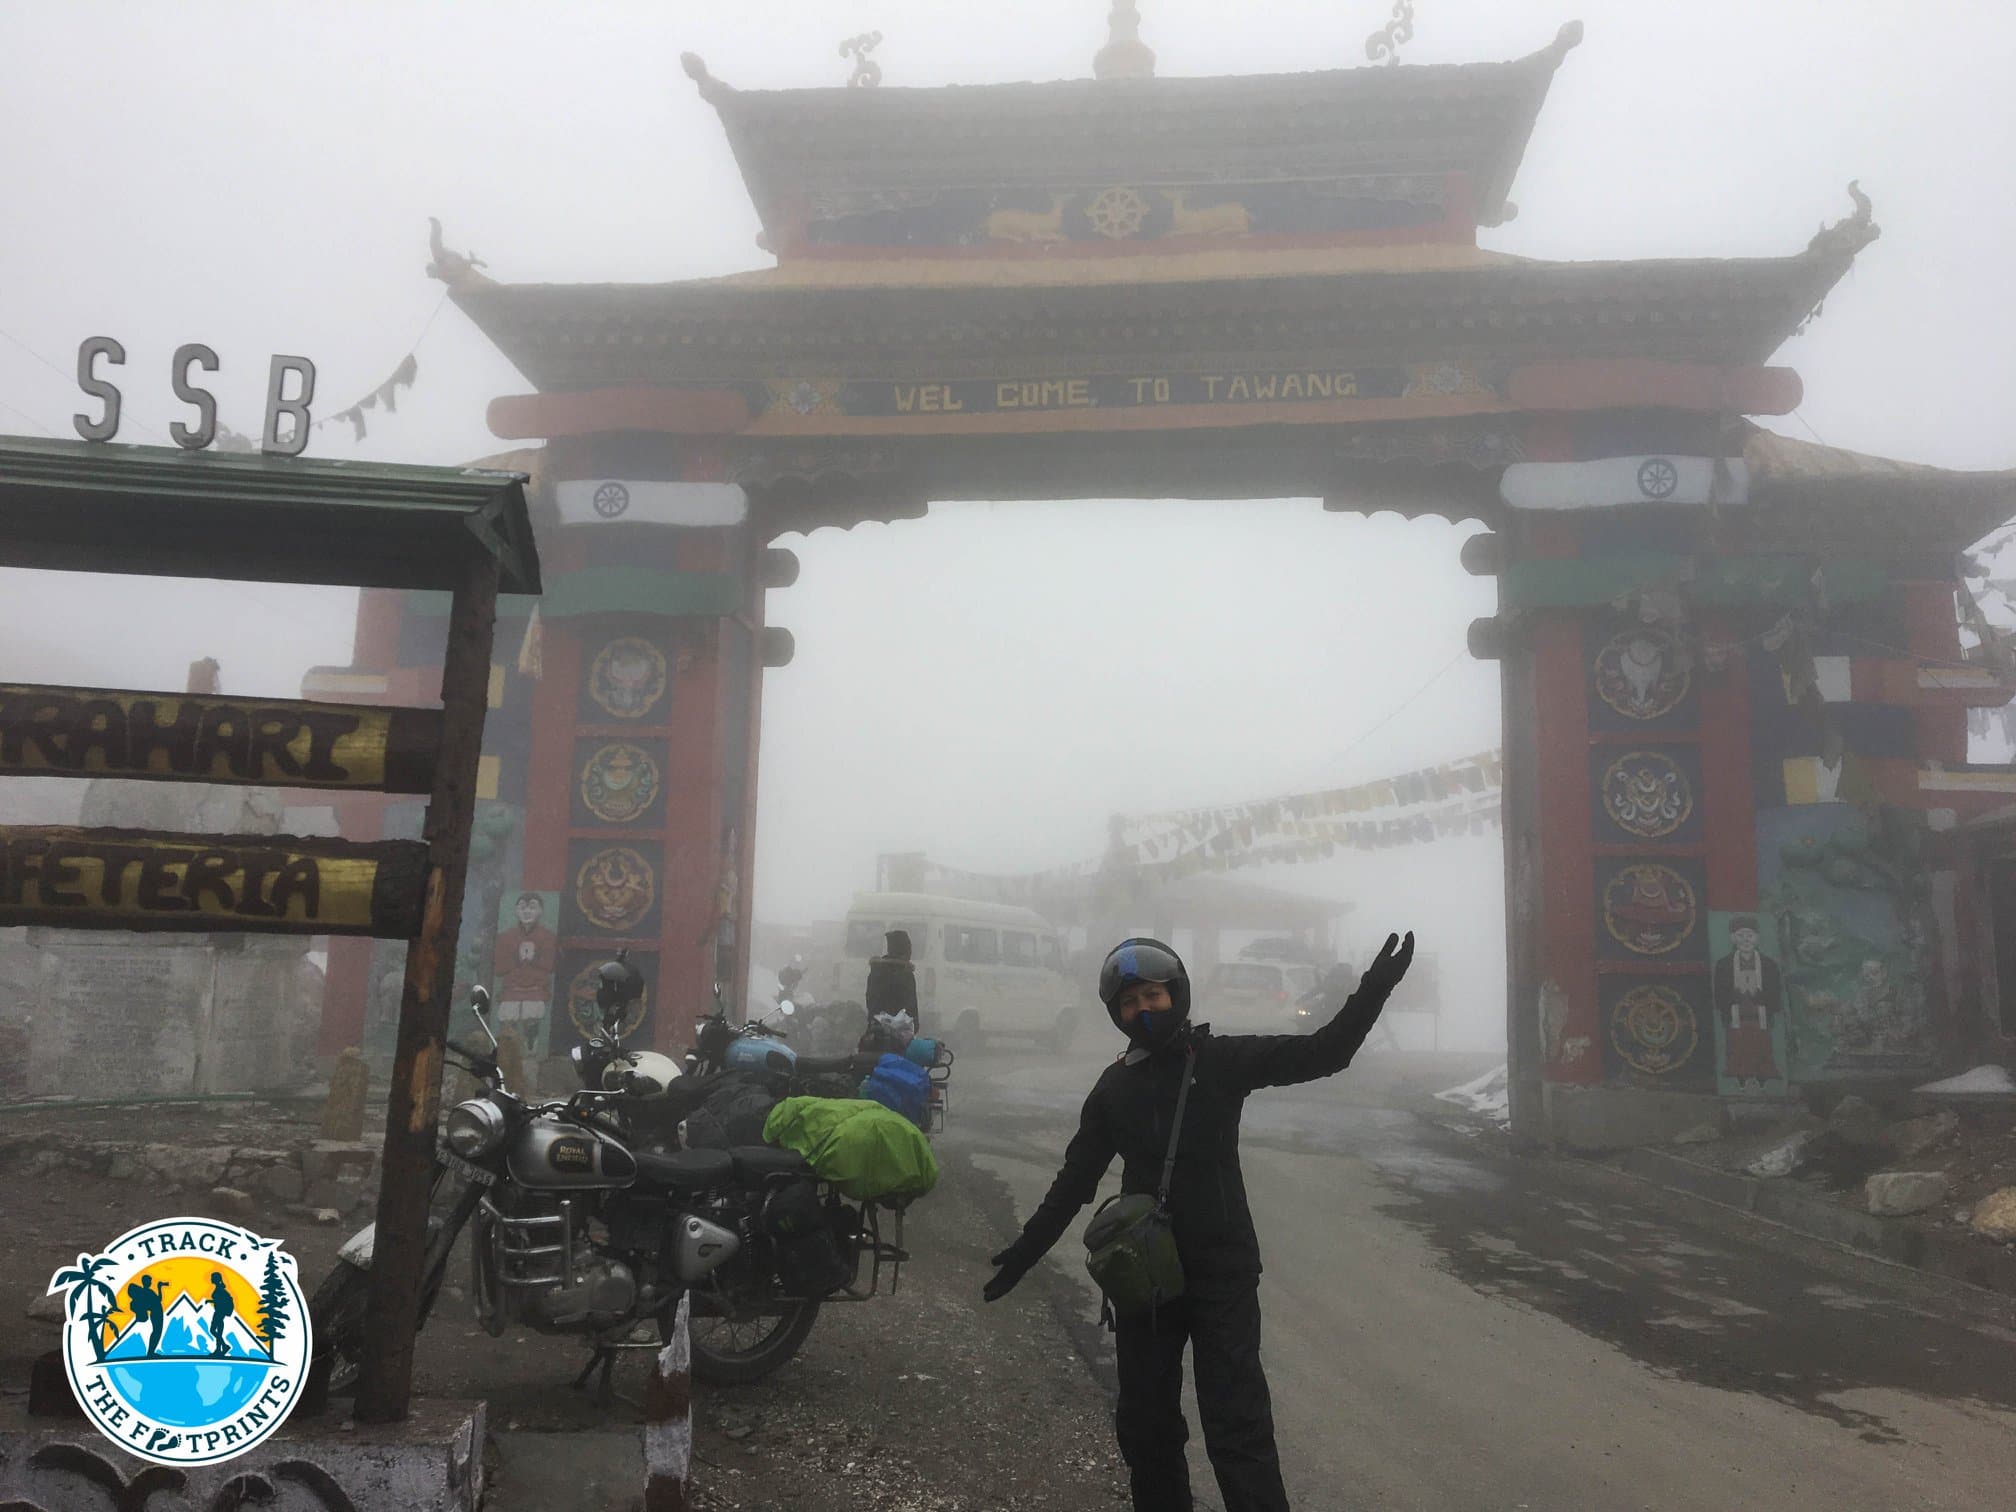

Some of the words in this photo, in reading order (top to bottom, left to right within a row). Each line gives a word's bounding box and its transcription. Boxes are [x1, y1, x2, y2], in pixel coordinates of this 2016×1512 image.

[894, 384, 963, 411] WEL
[996, 379, 1091, 409] COME
[1129, 376, 1170, 404] TO
[1200, 372, 1359, 400] TAWANG
[0, 692, 360, 781] RAHARI
